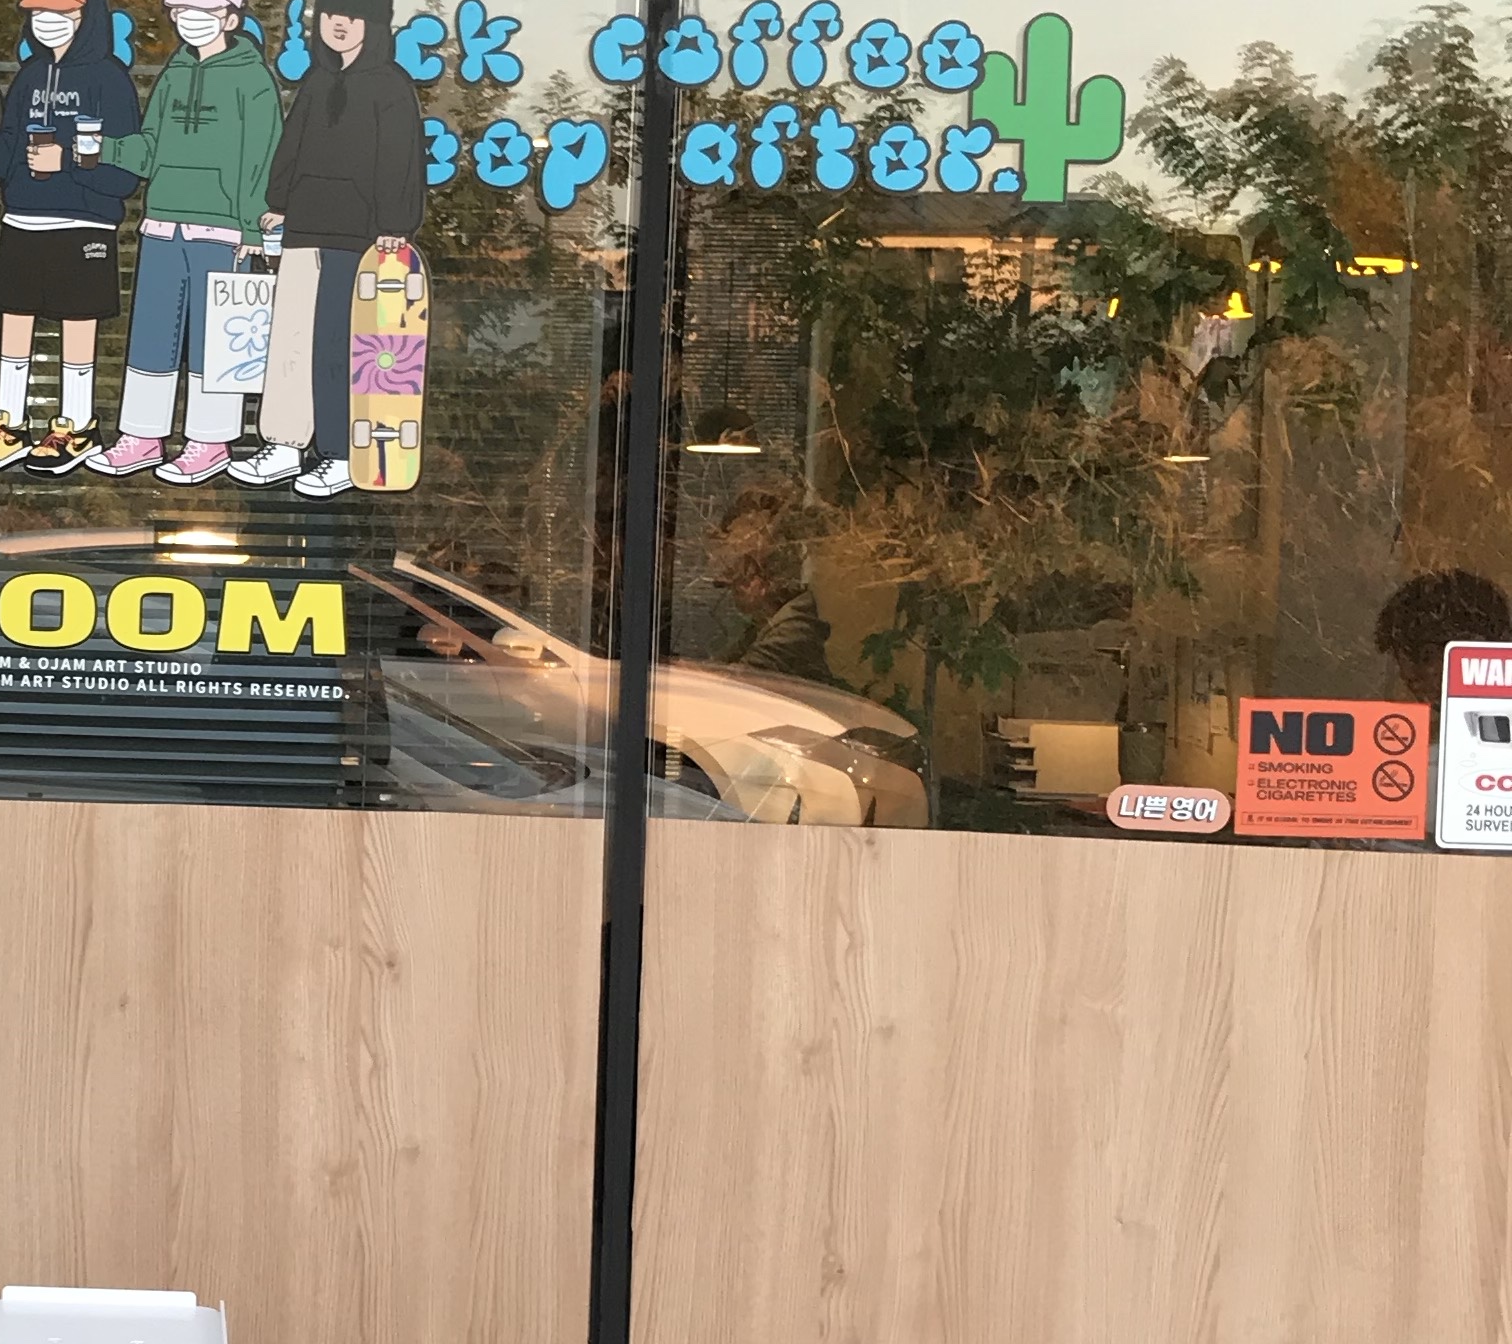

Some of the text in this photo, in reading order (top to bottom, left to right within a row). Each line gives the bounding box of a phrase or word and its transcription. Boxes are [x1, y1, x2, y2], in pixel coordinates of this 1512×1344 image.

[214, 279, 276, 307] BLOO
[18, 656, 31, 670] &
[37, 658, 86, 672] OJAM
[92, 659, 128, 673] ART
[134, 660, 203, 676] STUDIO
[20, 674, 56, 688] ART
[61, 675, 131, 691] STUDIO
[136, 678, 169, 693] ALL
[175, 680, 243, 696] RIGHTS
[249, 683, 351, 700] RESERVED.
[1249, 710, 1355, 757] NO
[1257, 761, 1334, 775] SMOKING
[1256, 777, 1358, 792] ELECTRONIC
[1256, 789, 1357, 803] CIGARETTES
[1119, 794, 1168, 818] 나쁜
[1170, 796, 1219, 822] 영어
[1465, 804, 1481, 817] 24
